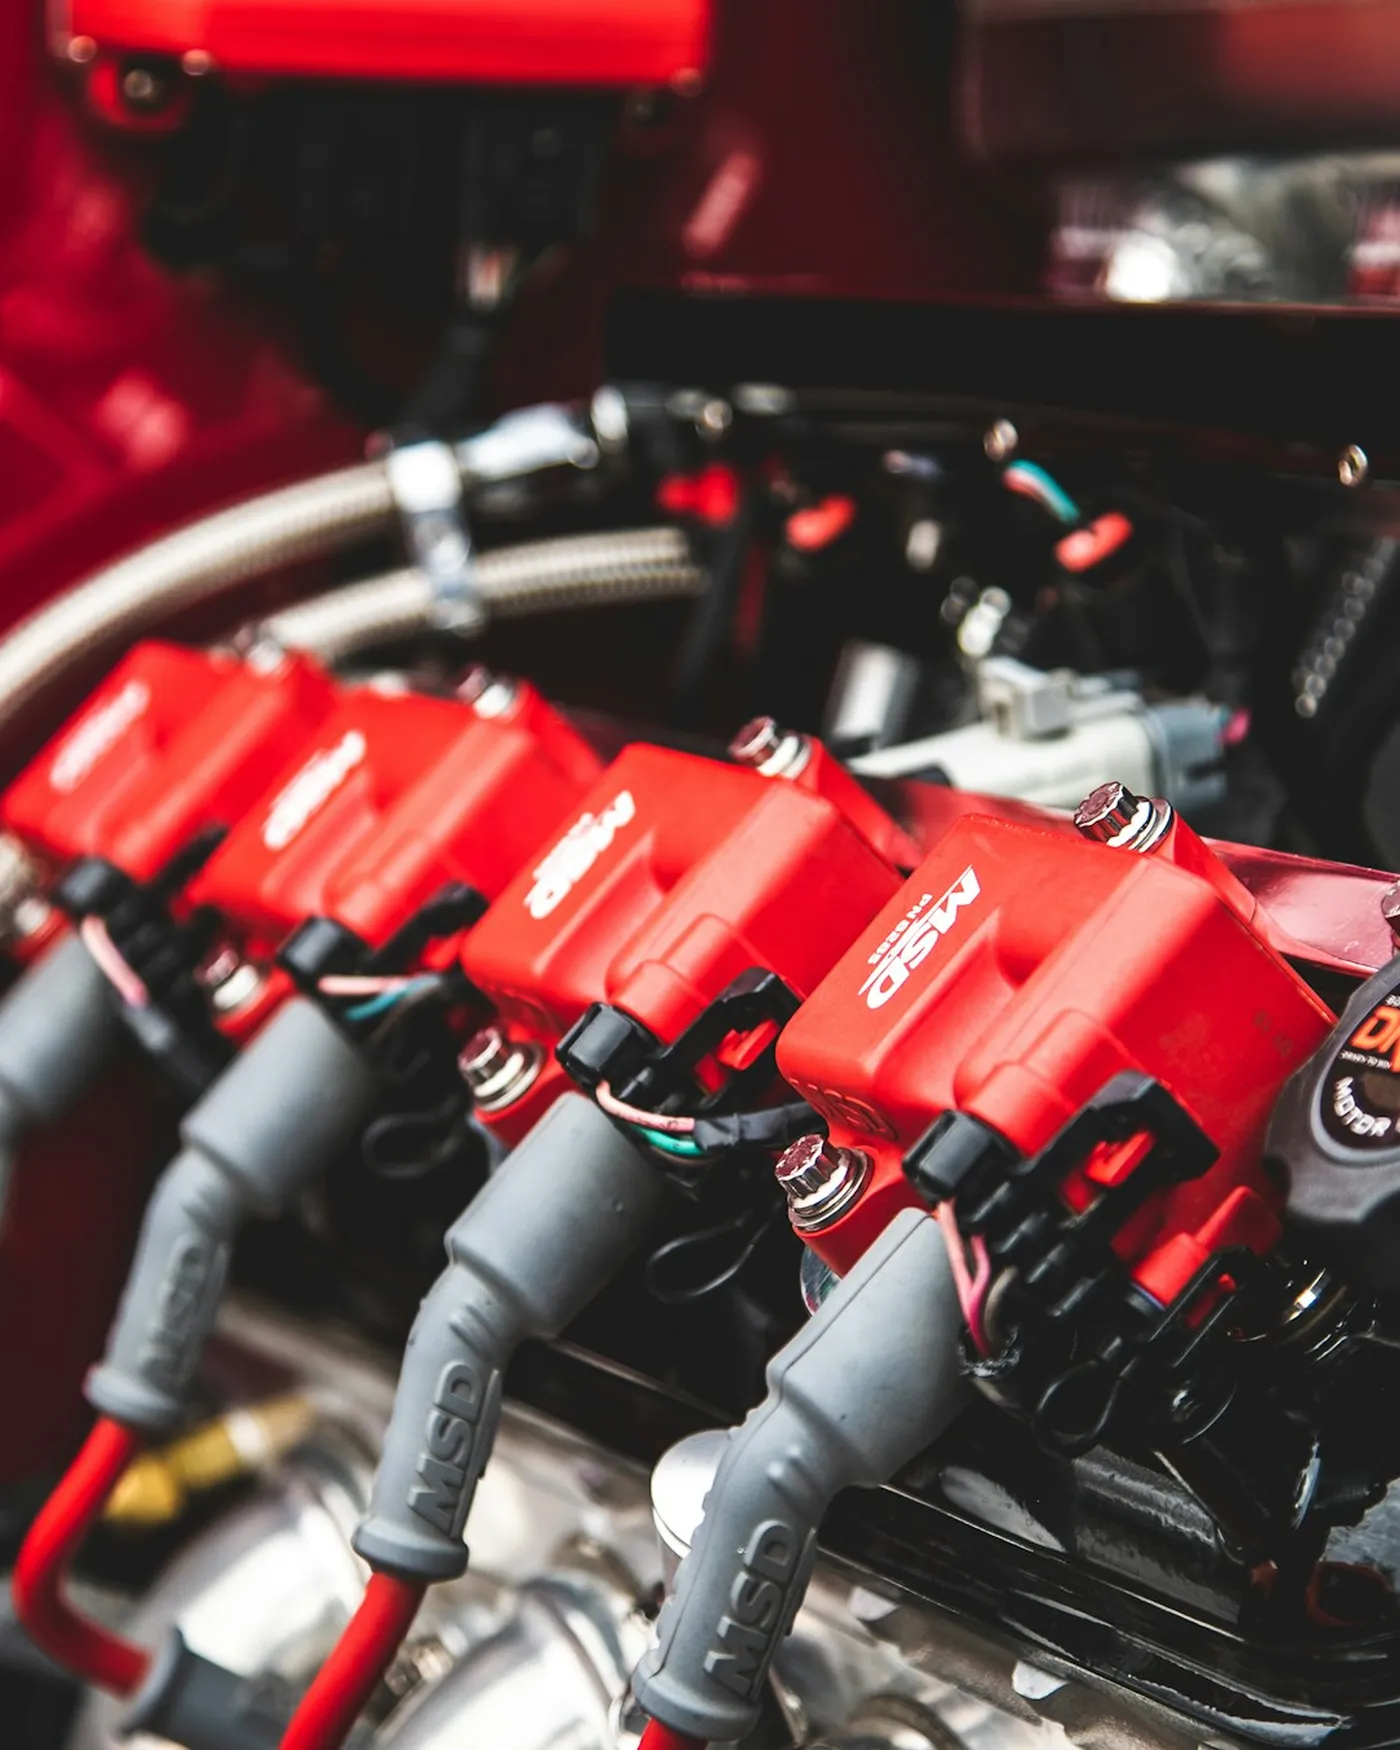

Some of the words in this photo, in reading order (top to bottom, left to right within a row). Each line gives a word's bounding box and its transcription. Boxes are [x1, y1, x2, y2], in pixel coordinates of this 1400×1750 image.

[863, 865, 980, 1009] MSD
[1334, 1076, 1392, 1137] MOTOR
[407, 1360, 483, 1535] MSD
[703, 1519, 794, 1697] MSD
